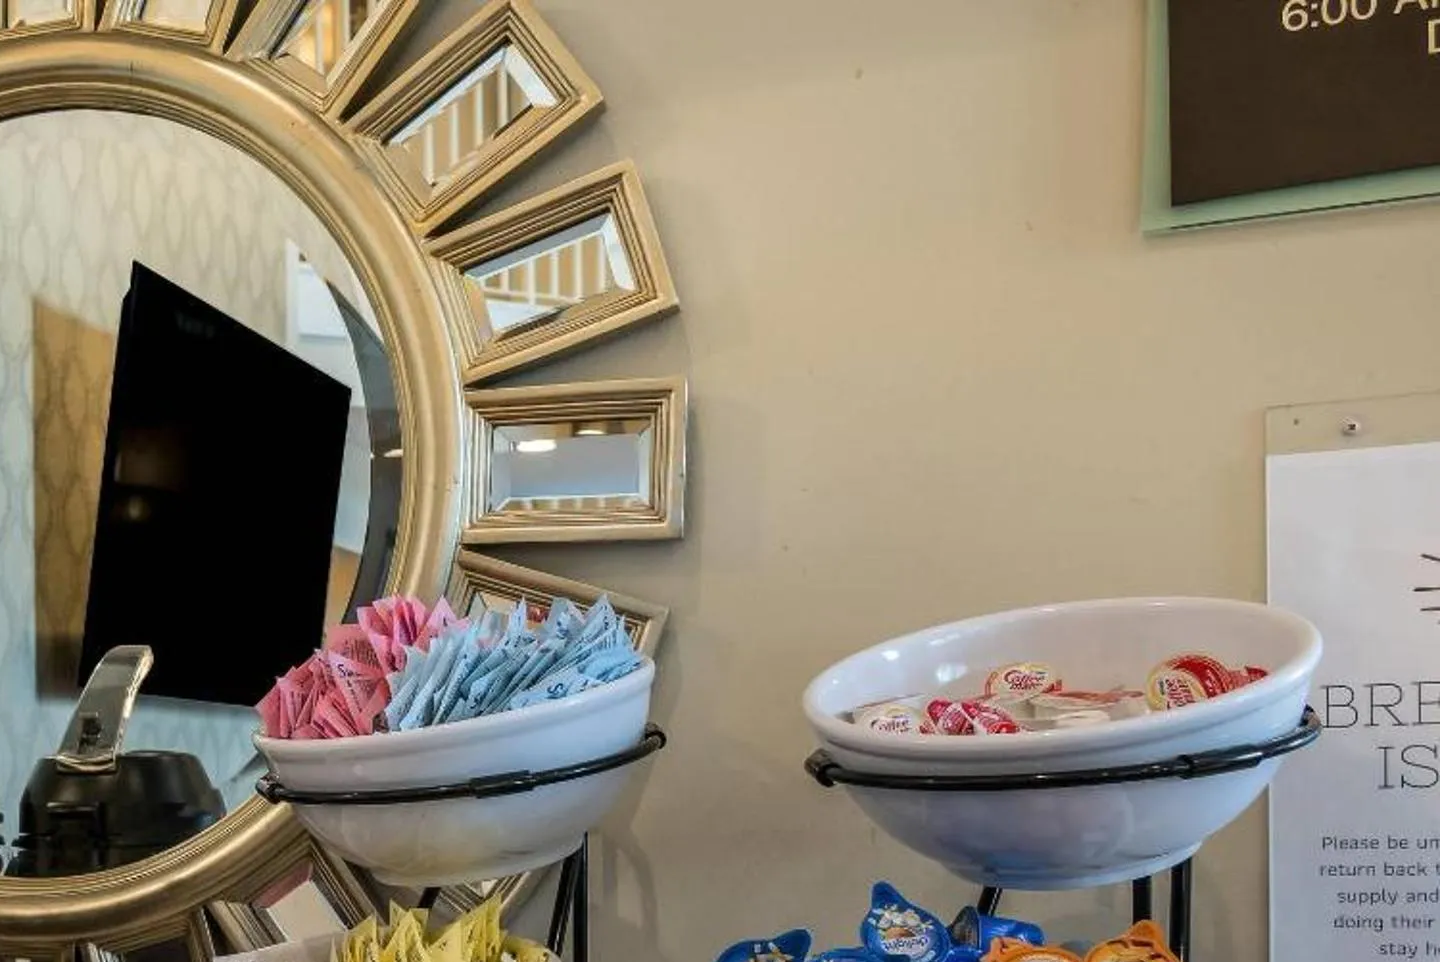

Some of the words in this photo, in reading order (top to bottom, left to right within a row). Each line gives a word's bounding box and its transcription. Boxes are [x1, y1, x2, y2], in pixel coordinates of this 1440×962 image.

[1282, 0, 1377, 31] 6:00
[1377, 744, 1439, 789] IS
[1322, 836, 1380, 850] Please
[1387, 835, 1409, 850] be
[1320, 864, 1375, 876] return
[1383, 861, 1428, 877] back
[1337, 887, 1398, 905] supply
[1406, 887, 1440, 903] and
[1333, 915, 1384, 932] doing
[1390, 914, 1436, 928] their
[1379, 942, 1417, 959] stay
[1426, 941, 1440, 956] h
